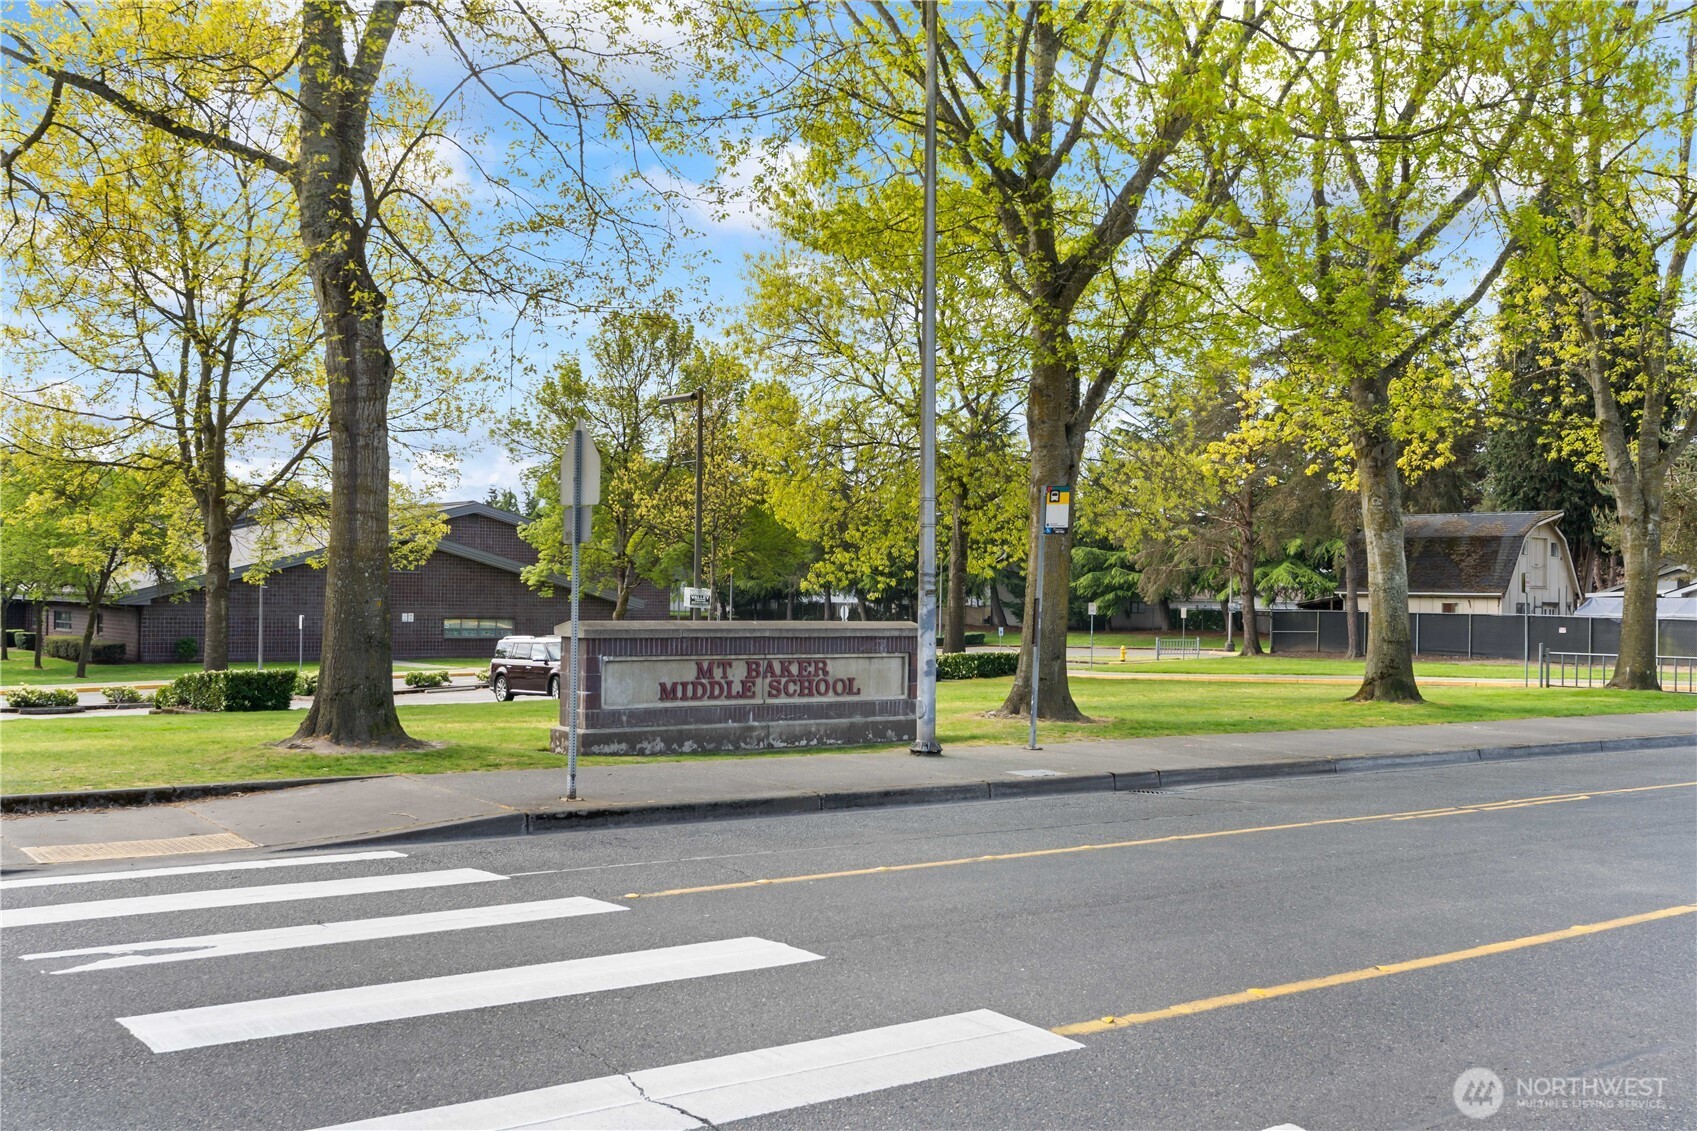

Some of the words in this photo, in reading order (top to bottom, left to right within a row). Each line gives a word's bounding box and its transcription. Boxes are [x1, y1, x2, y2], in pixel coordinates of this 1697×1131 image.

[745, 659, 829, 679] BAKER
[659, 680, 756, 701] MIDDLE
[768, 677, 861, 698] SCHOOL
